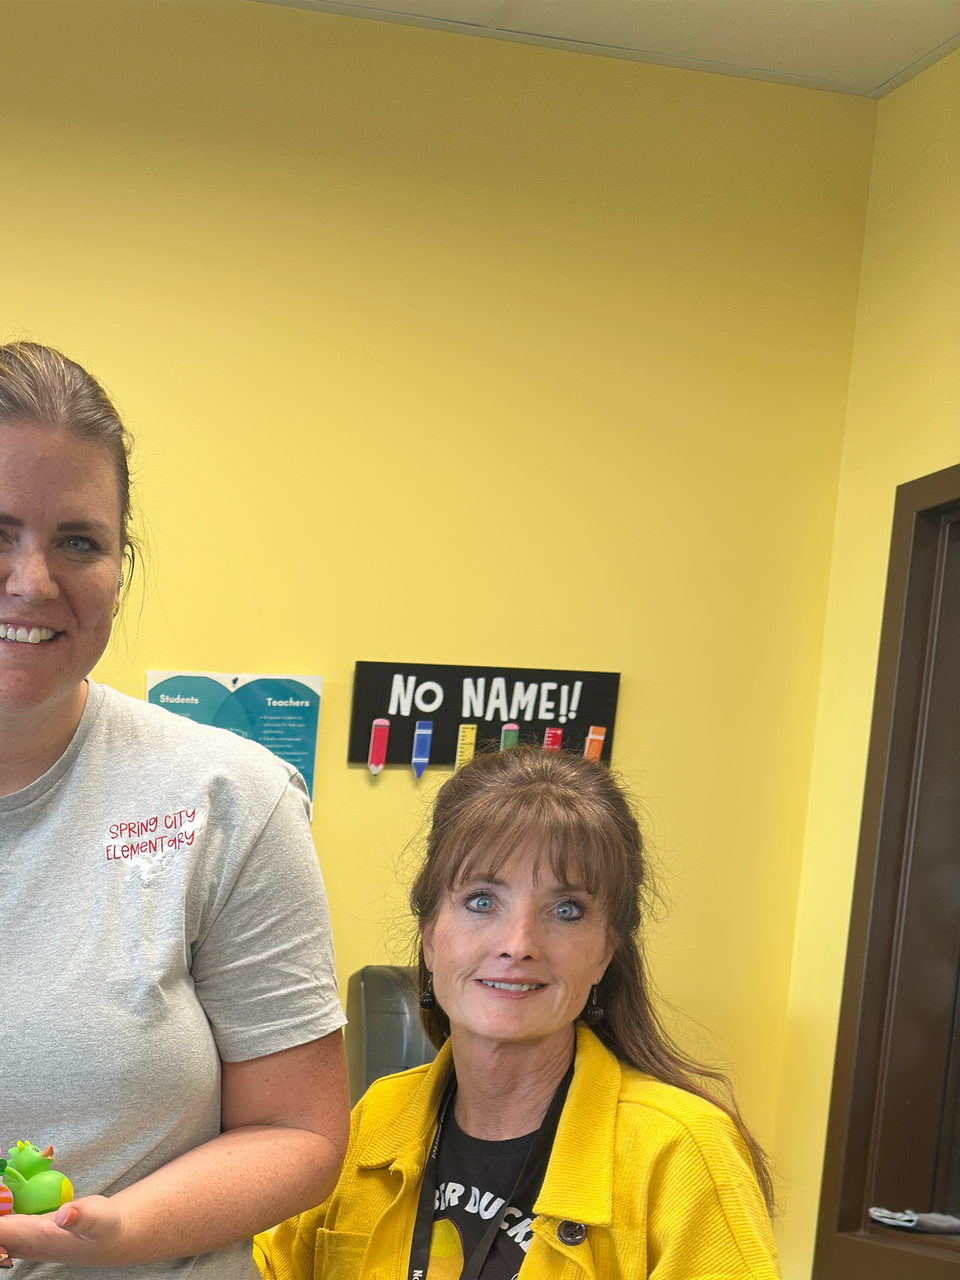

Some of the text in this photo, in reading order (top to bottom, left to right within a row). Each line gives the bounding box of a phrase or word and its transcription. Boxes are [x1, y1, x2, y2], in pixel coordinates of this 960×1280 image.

[159, 694, 200, 704] Students
[266, 697, 310, 707] Teachers
[388, 673, 583, 724] NO NAME!!
